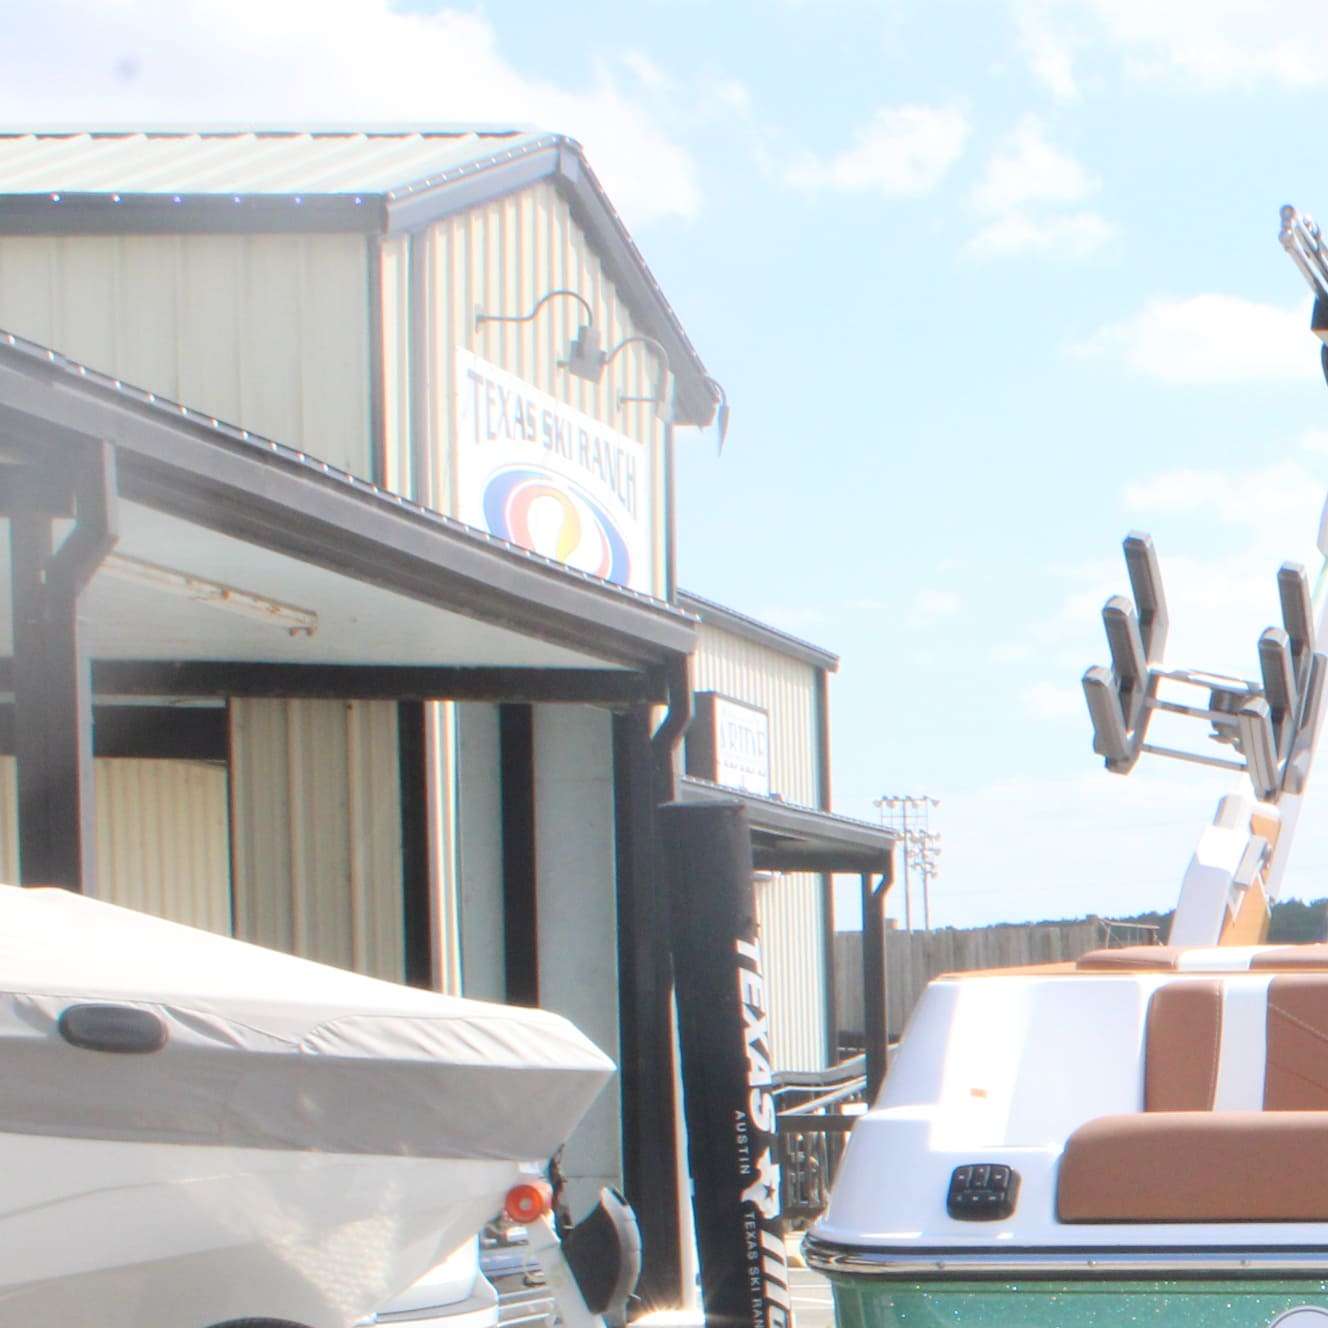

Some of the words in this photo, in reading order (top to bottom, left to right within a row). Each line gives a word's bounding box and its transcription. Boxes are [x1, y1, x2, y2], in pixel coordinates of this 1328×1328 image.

[466, 368, 537, 445] TEXAS
[542, 409, 573, 461] SKI
[578, 426, 638, 521] RANCH
[736, 937, 777, 1135] TEXAS
[735, 1110, 751, 1176] AUSTIN
[744, 1211, 759, 1261] TEXAS
[749, 1265, 761, 1292] SKI
